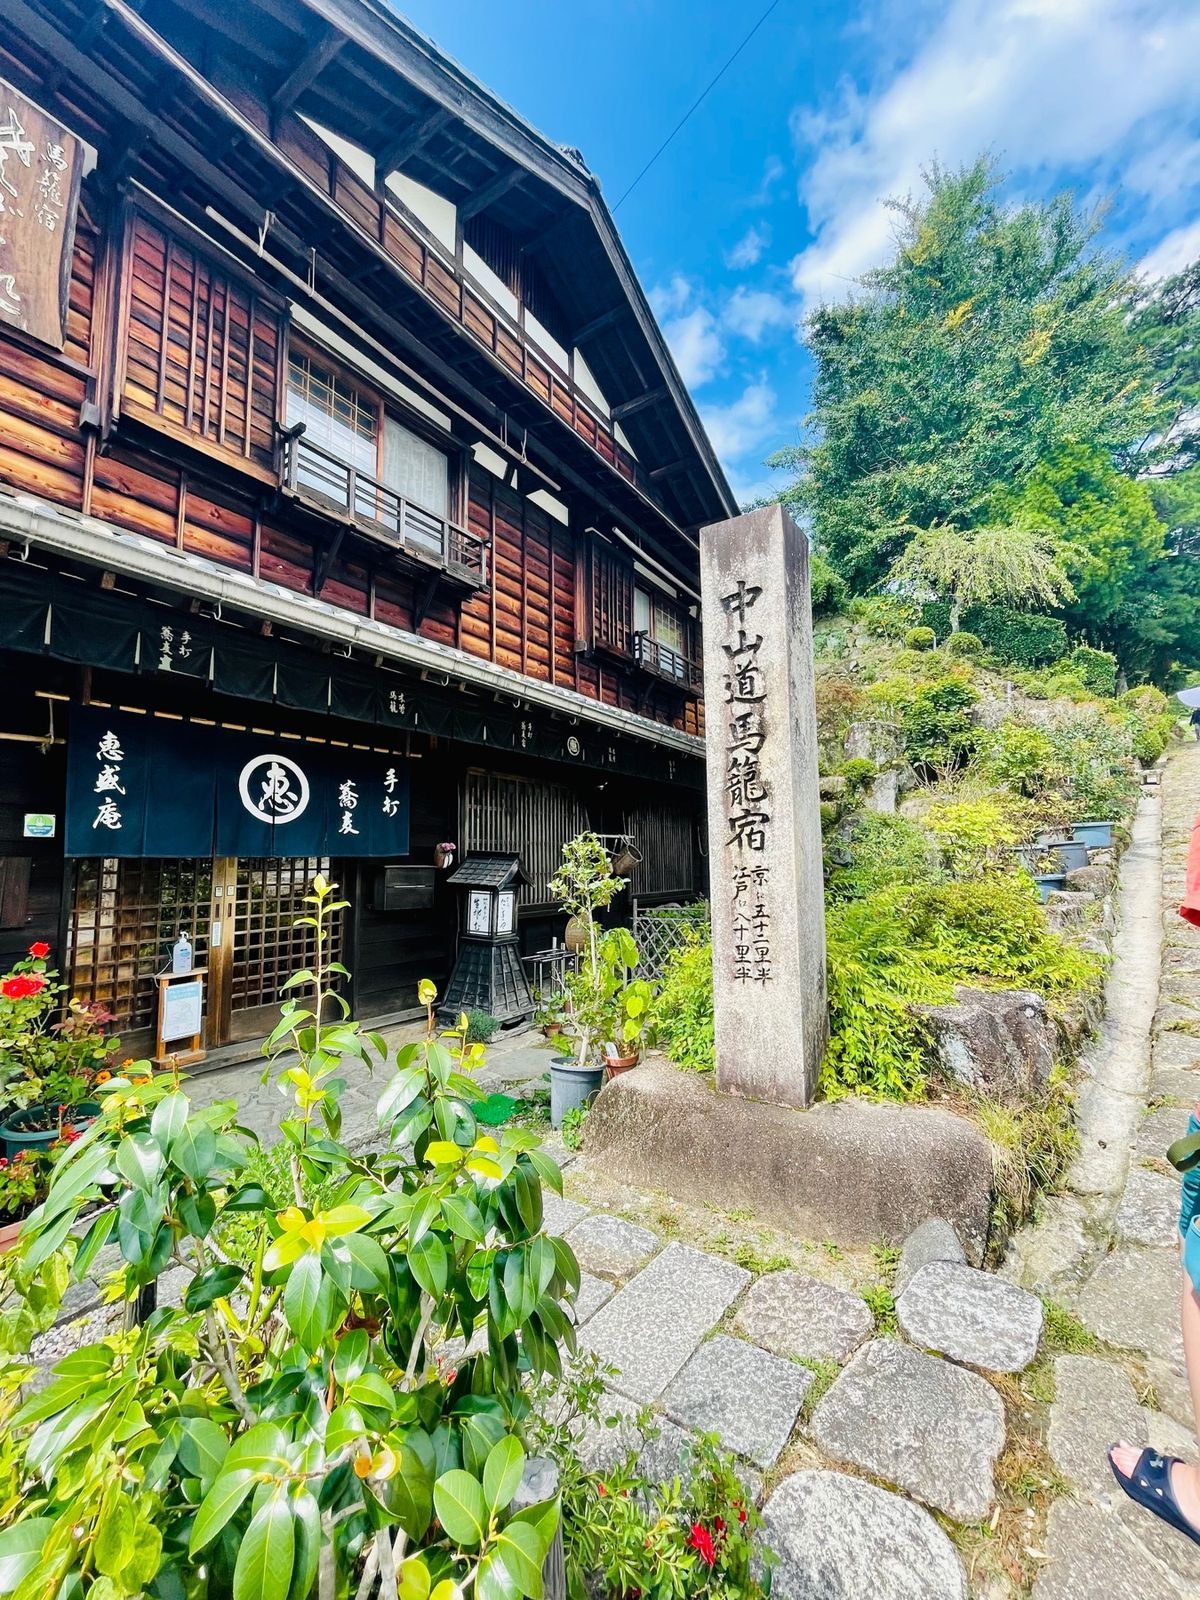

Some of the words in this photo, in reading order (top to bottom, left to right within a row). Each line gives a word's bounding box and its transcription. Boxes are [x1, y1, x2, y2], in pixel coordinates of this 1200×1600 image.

[34, 141, 69, 232] 馬籠宿
[178, 631, 193, 658] 手打
[719, 580, 771, 851] 中山道馬籠宿
[338, 778, 360, 835] 蕎麦
[382, 768, 400, 817] 手打
